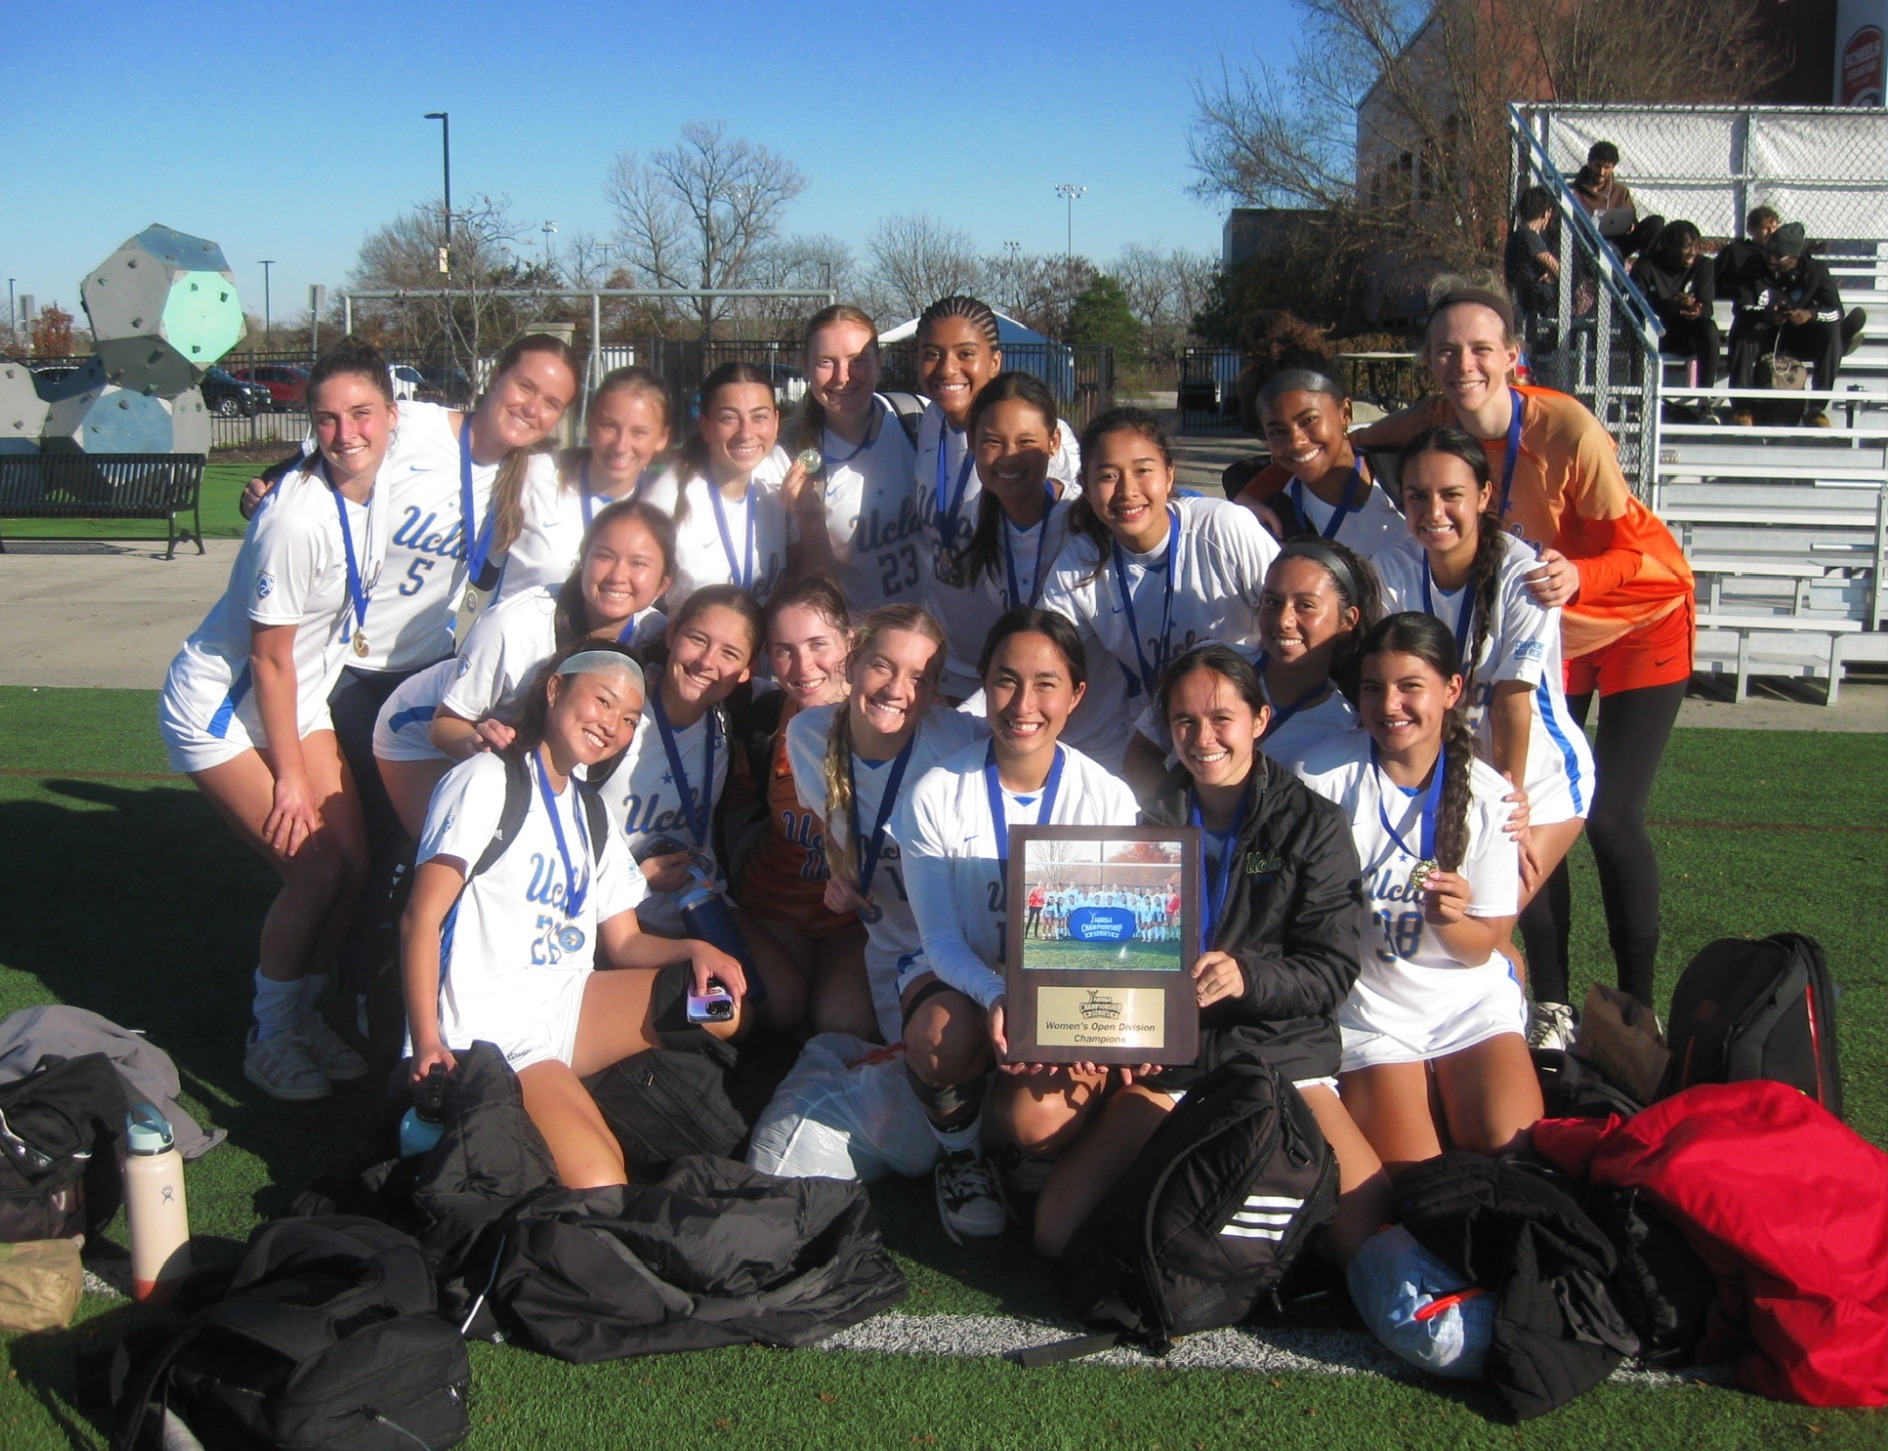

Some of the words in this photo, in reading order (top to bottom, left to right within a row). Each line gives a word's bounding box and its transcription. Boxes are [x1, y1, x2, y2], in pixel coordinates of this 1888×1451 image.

[398, 556, 436, 597] 5
[877, 543, 920, 598] 23
[1373, 908, 1424, 964] 38
[1046, 1021, 1089, 1031] Women's
[1091, 1022, 1116, 1032] Open
[1118, 1023, 1155, 1032] Division
[1074, 1034, 1126, 1044] Champions
